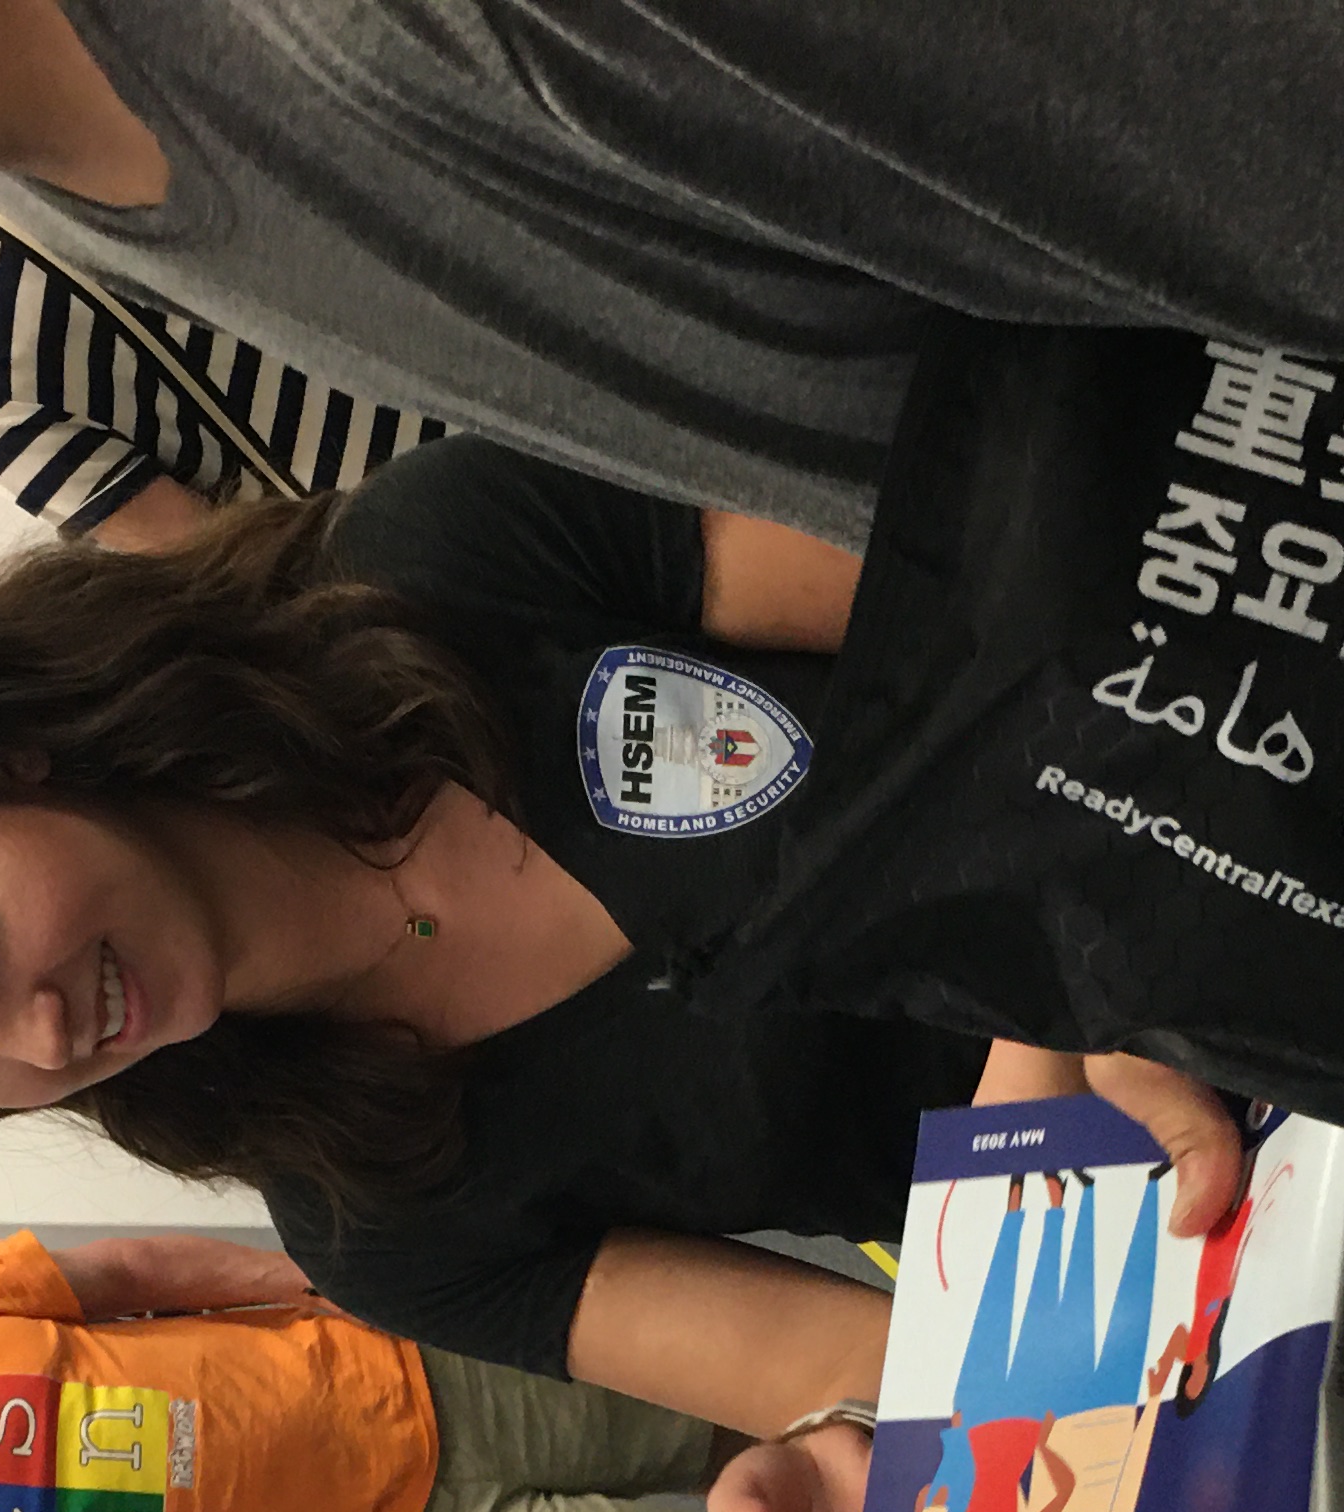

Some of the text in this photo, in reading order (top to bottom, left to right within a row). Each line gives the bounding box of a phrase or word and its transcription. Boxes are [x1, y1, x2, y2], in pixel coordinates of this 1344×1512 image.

[620, 674, 657, 804] HSEM
[626, 651, 803, 743] EMERGENCY MANAGEMENT
[1092, 618, 1316, 783] هامة
[617, 760, 802, 833] HOMELAND SECURITY
[1009, 1127, 1046, 1149] MAY
[168, 1397, 198, 1488] network
